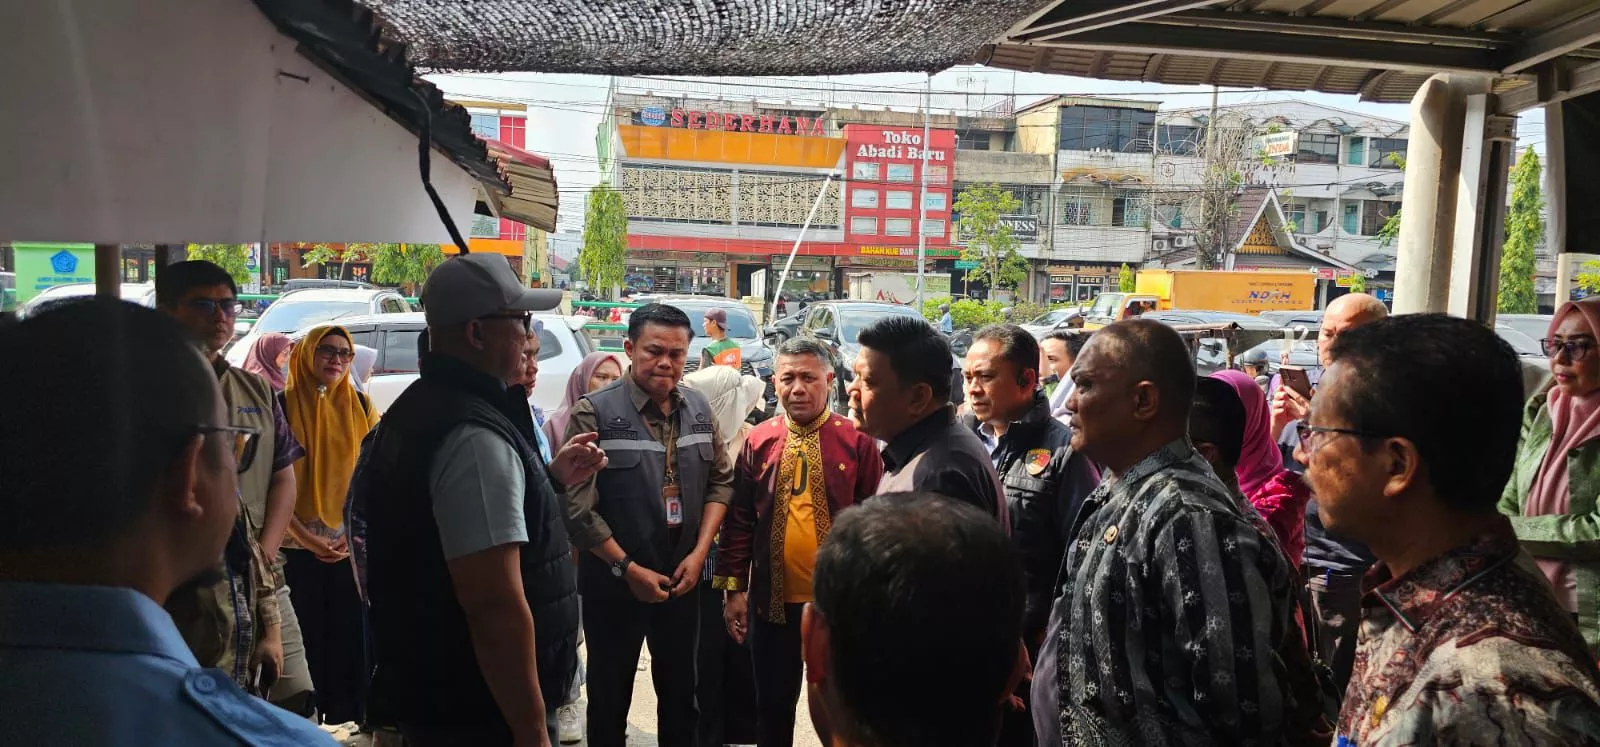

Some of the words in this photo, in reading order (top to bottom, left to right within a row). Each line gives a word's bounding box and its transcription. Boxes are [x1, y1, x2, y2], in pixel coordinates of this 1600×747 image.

[670, 107, 825, 136] SEDERHANA
[882, 129, 922, 146] Toko
[856, 143, 903, 160] Abadi
[907, 145, 946, 161] Baru
[899, 248, 914, 256] DAN
